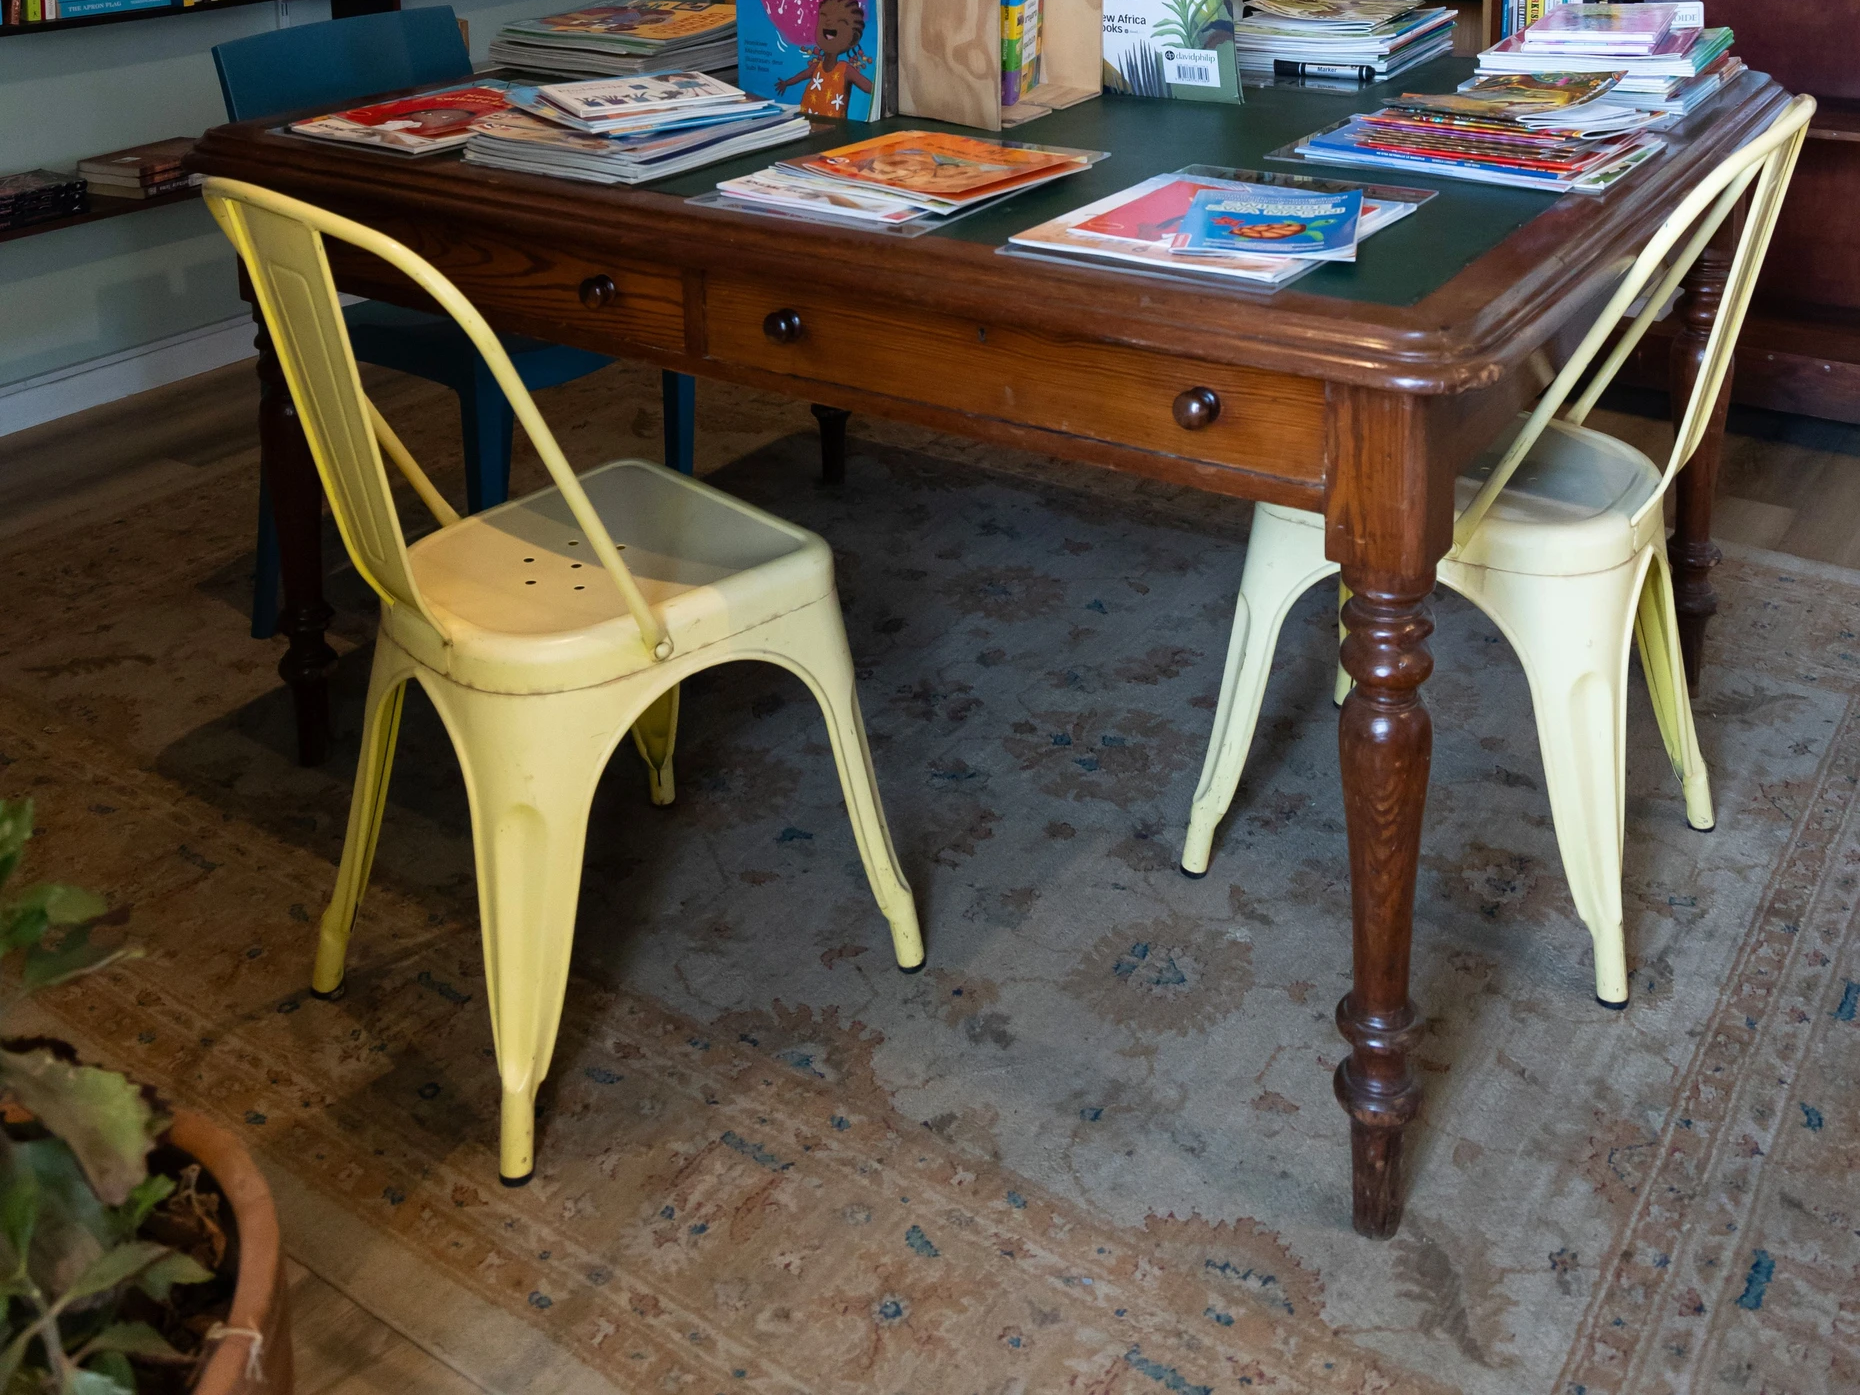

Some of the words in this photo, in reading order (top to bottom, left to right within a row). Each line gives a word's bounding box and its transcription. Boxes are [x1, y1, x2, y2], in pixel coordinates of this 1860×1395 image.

[1103, 15, 1116, 23] ew
[1118, 15, 1146, 25] Africa
[1103, 23, 1122, 33] ooks
[1176, 52, 1216, 63] davidphilip
